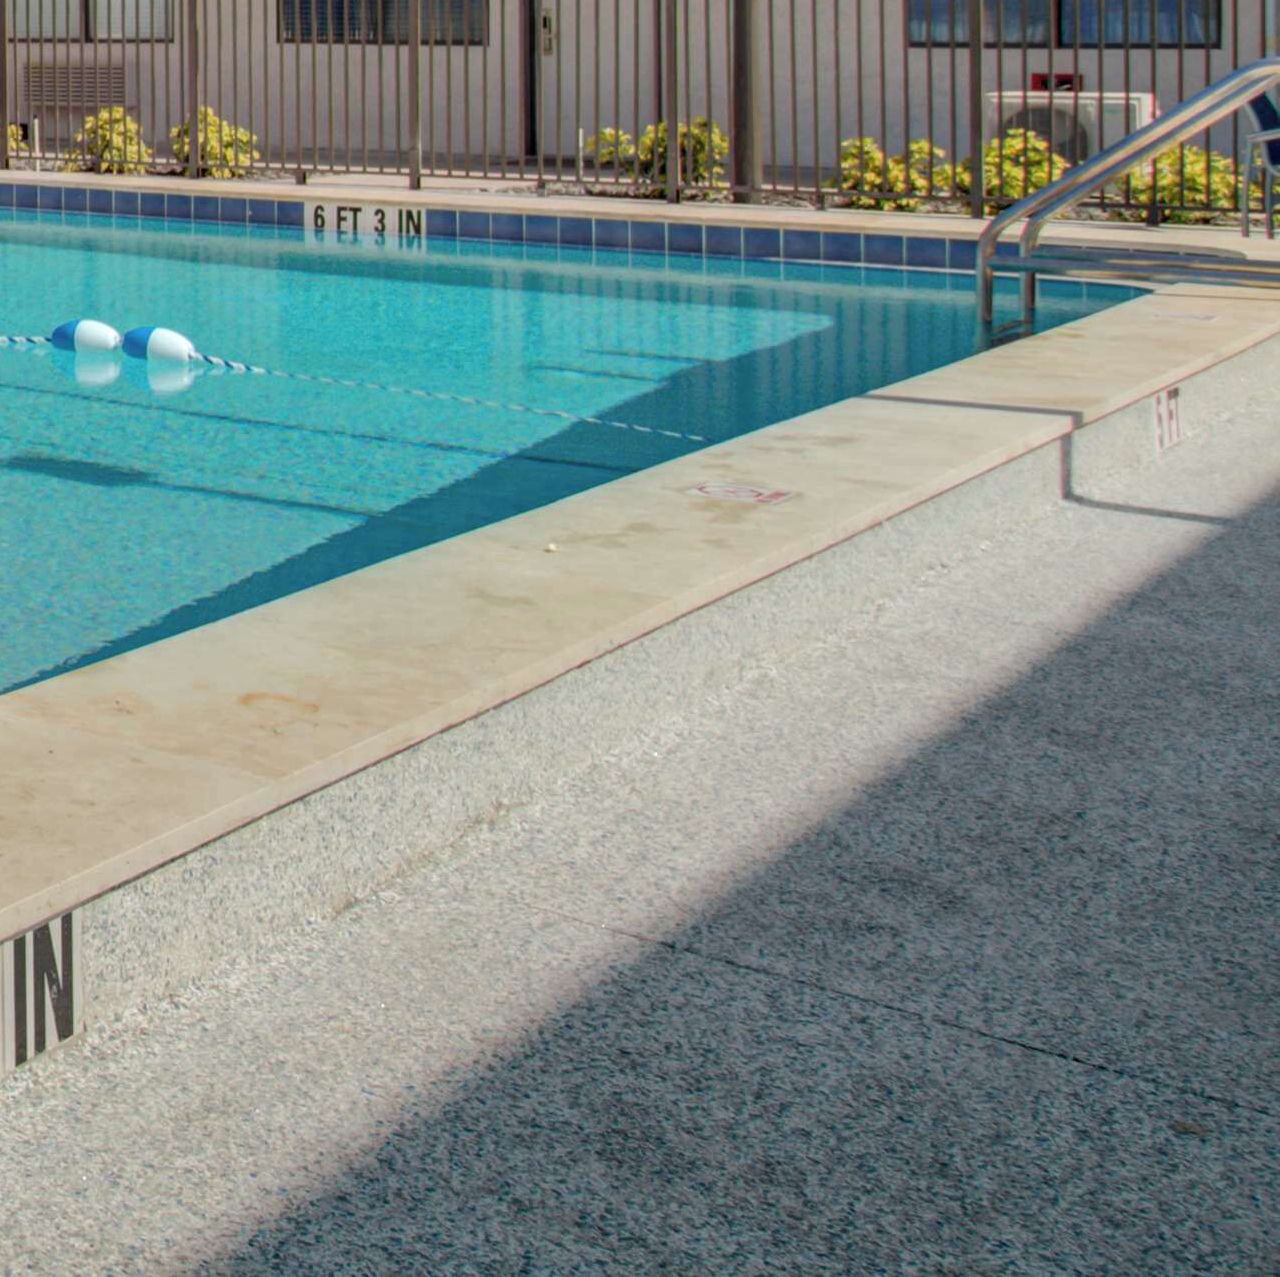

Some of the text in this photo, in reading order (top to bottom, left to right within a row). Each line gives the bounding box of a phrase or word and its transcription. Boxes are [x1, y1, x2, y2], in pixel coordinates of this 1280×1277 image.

[314, 205, 422, 235] 6 FT 3 IN
[14, 911, 74, 1067] IN
